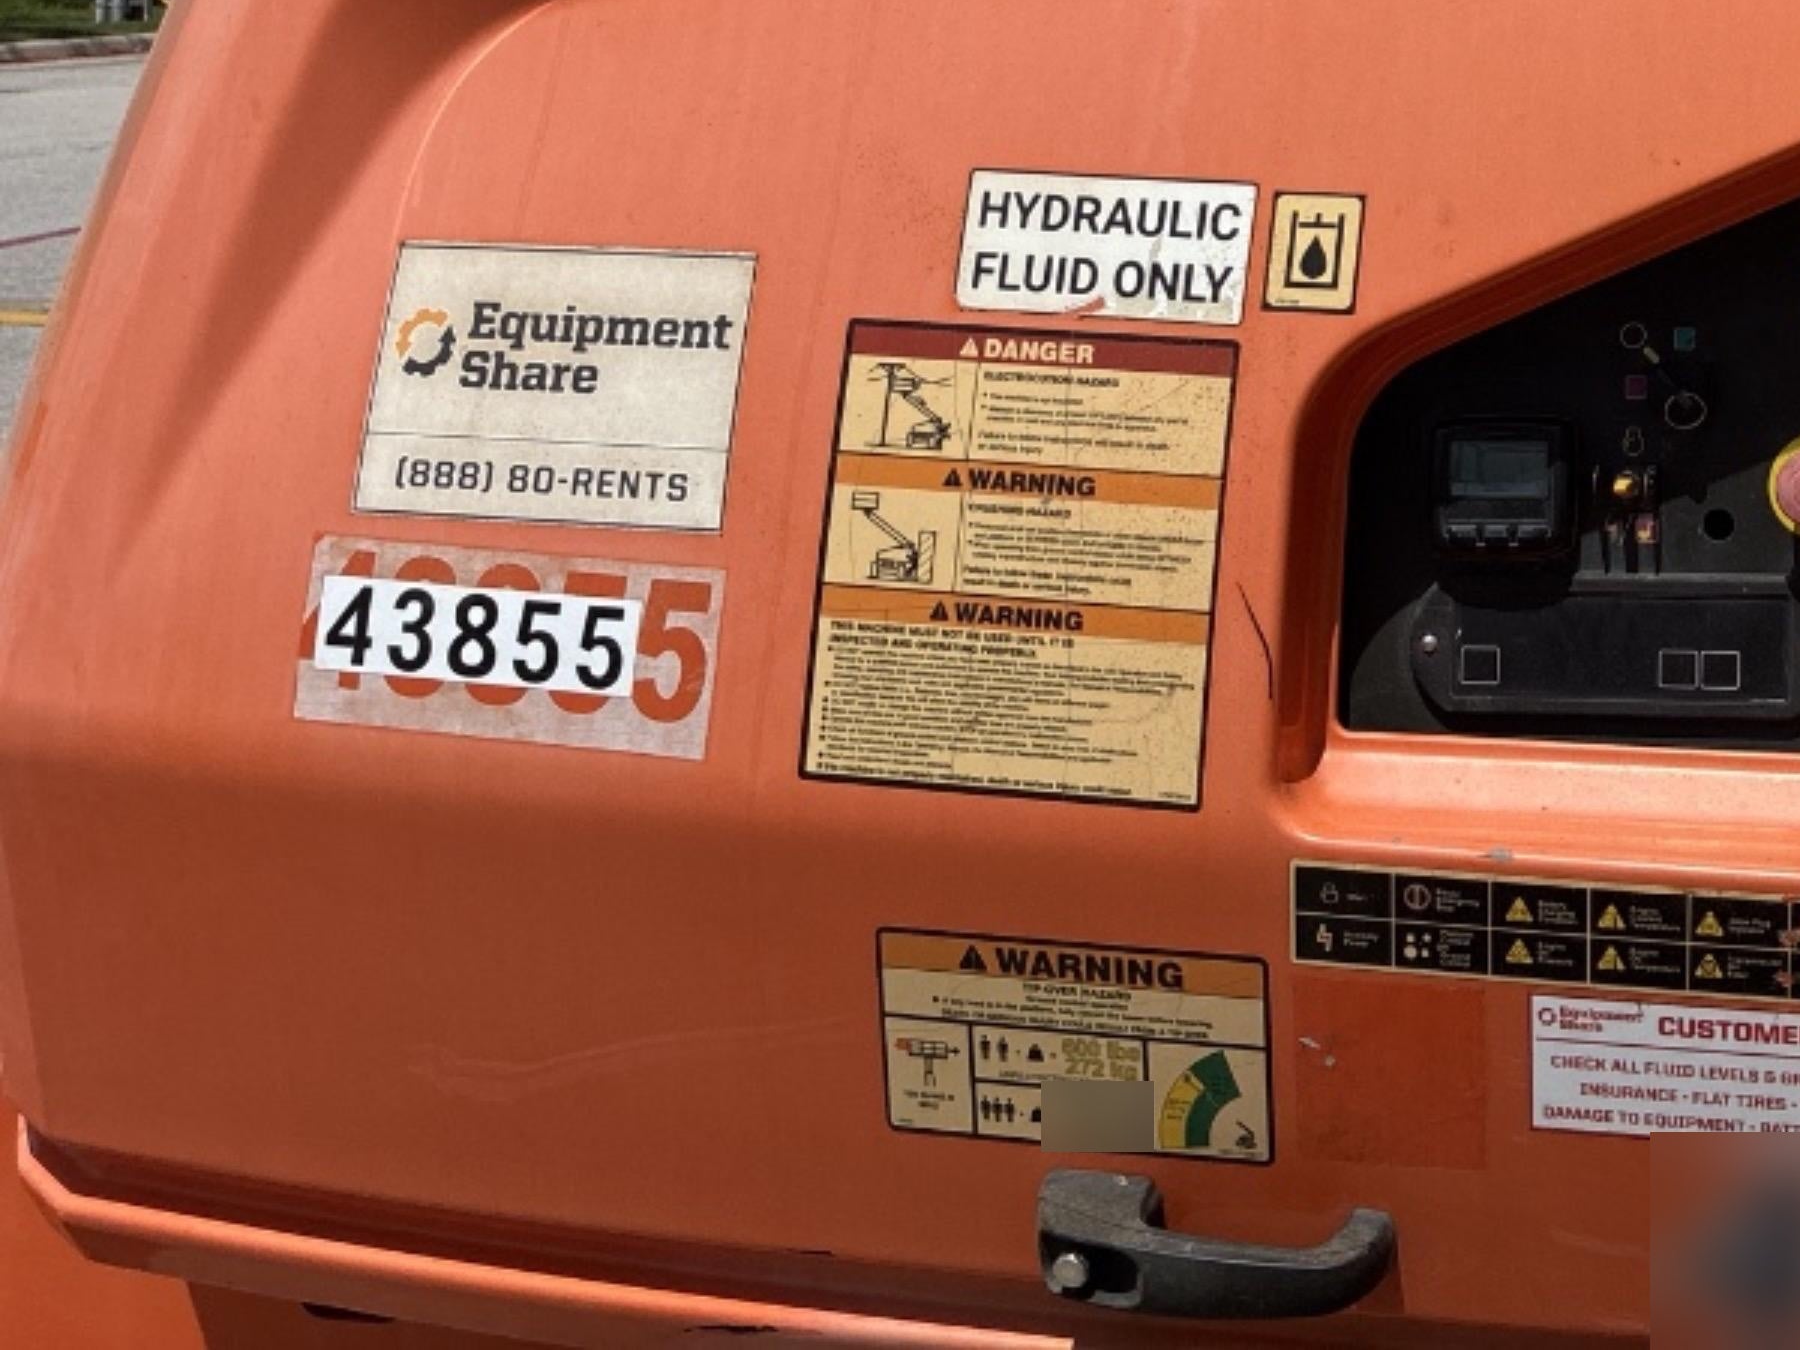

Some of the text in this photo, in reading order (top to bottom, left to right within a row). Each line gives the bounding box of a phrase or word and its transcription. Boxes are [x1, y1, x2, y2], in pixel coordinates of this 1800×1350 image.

[979, 190, 1242, 241] HYDRAULIC
[970, 252, 1234, 304] FLUID ONLY
[468, 302, 733, 353] Equipment
[459, 350, 600, 394] Share
[983, 338, 1095, 365] DANGER
[395, 456, 690, 502] (888) 80-RENTS
[968, 468, 1096, 496] WARNING
[325, 584, 627, 691] 43855
[953, 601, 1084, 632] WARNING
[995, 947, 1183, 989] WARNING
[1551, 1055, 1606, 1072] CHECK
[1611, 1058, 1641, 1074] ALL
[1643, 1061, 1694, 1078] FLUID
[1700, 1064, 1759, 1084] LEVELS
[1580, 1082, 1678, 1103] INSURANCE
[1691, 1091, 1729, 1106] FLAT
[1736, 1094, 1786, 1110] TIRES
[1543, 1106, 1615, 1123] DAMAGE
[1619, 1110, 1639, 1126] TO
[1643, 1112, 1745, 1132] EQUIPMENT
